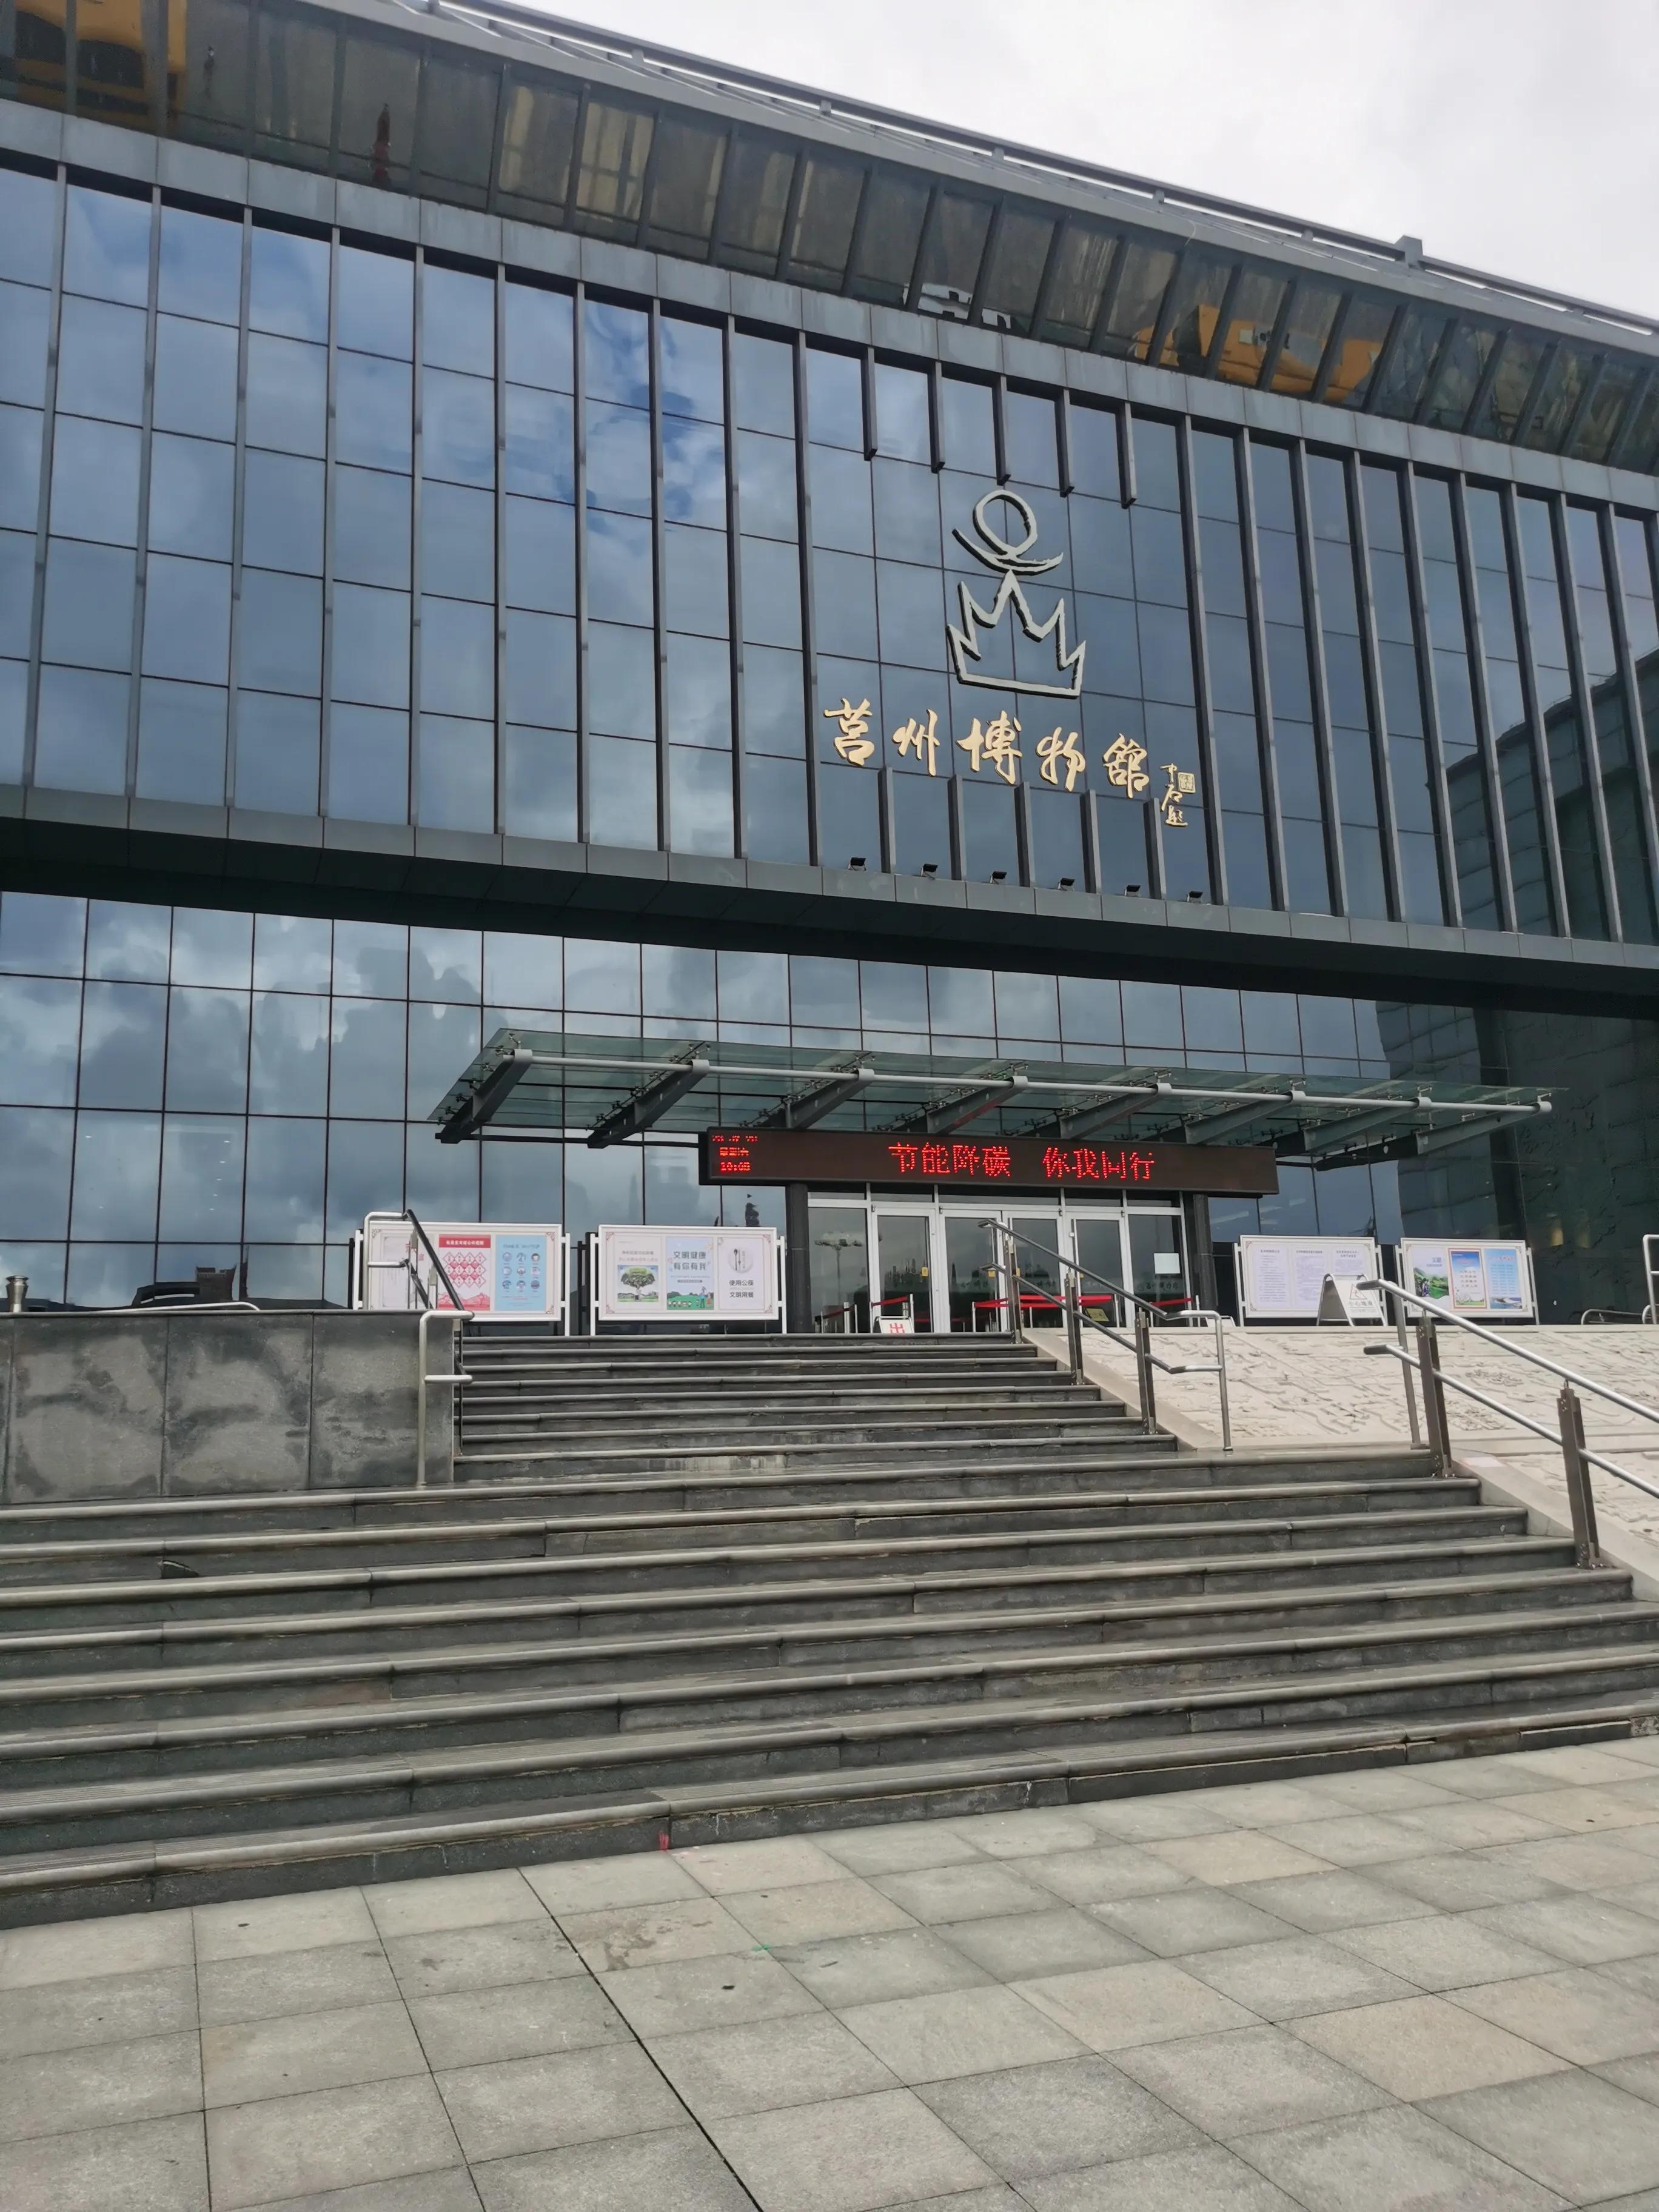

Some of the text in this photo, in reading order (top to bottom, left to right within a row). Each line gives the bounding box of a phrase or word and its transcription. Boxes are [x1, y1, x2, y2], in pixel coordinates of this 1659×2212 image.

[888, 1141, 1156, 1181] 节能降碳 你我同行
[673, 1251, 706, 1259] 文明健康
[674, 1262, 706, 1271] 有你有我
